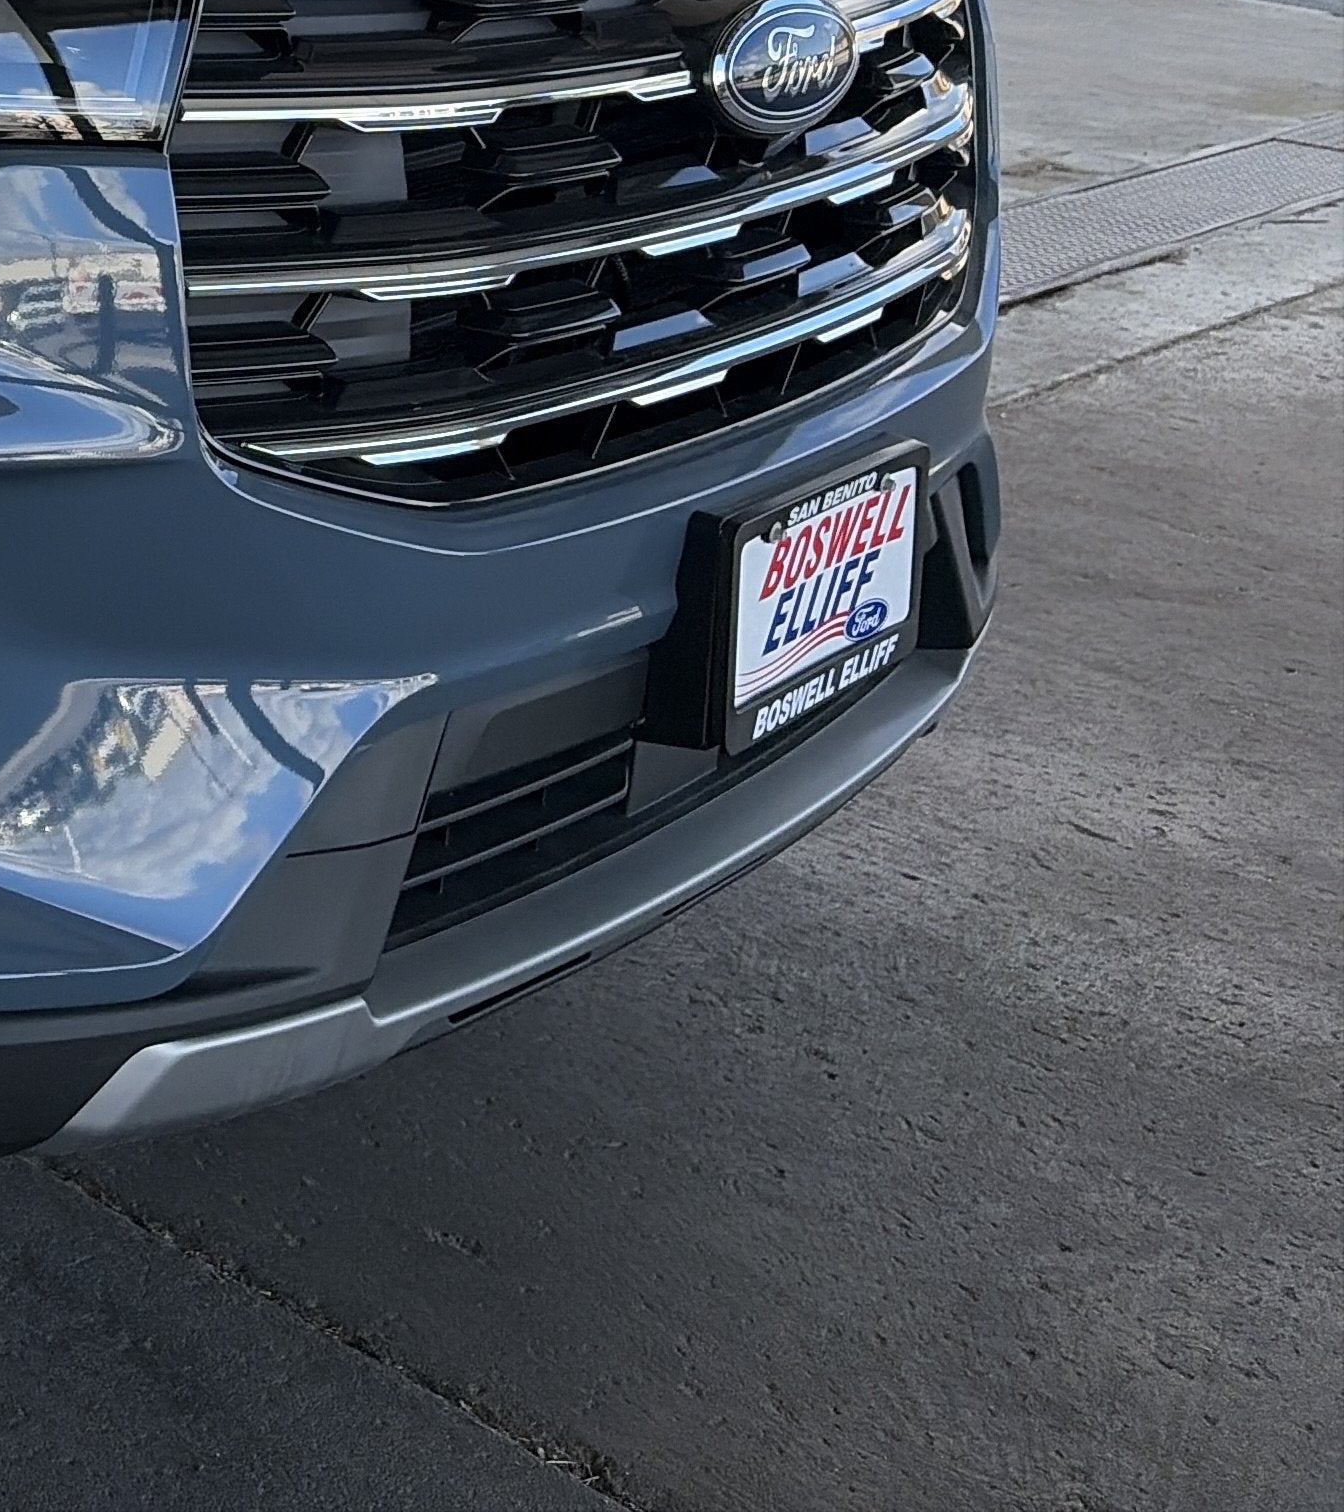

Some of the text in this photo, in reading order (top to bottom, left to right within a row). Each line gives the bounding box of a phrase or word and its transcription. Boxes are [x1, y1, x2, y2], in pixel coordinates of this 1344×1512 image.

[761, 24, 839, 95] Ford
[758, 484, 912, 603] BOSWELL
[787, 471, 879, 528] SAN BENITO
[761, 548, 882, 658] ELLIFF
[851, 604, 883, 637] Ford
[752, 633, 899, 740] BOSWELL ELLIFF
